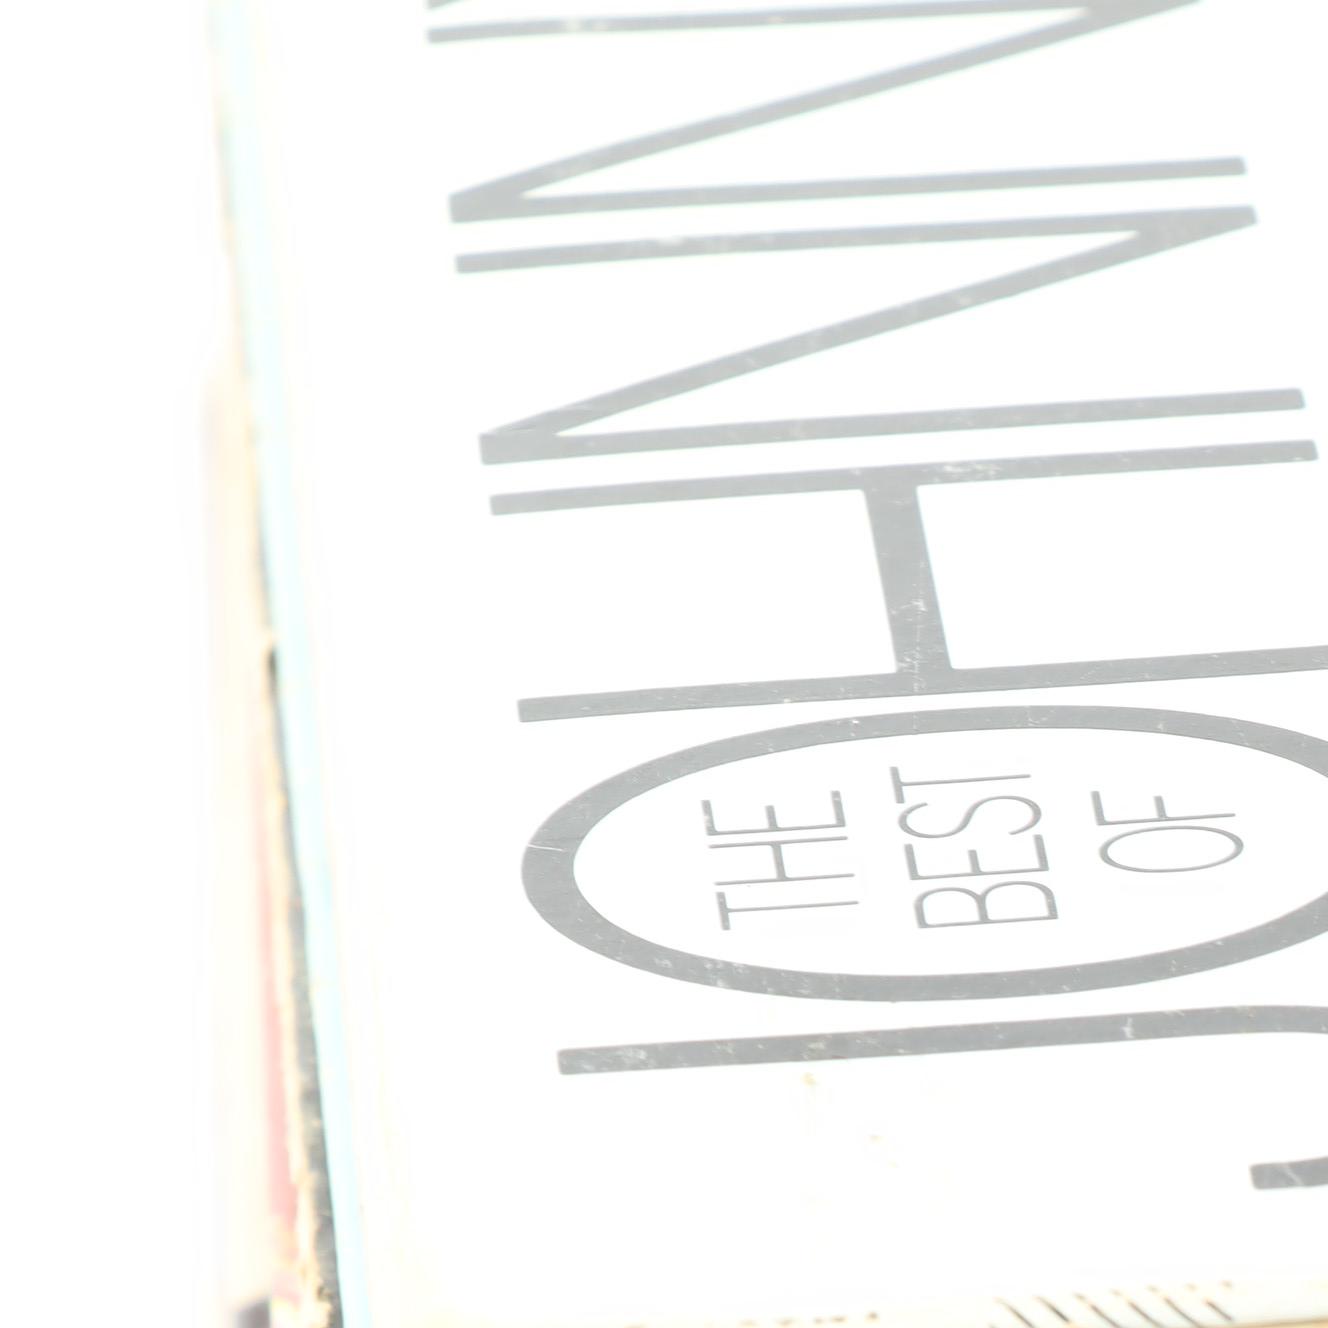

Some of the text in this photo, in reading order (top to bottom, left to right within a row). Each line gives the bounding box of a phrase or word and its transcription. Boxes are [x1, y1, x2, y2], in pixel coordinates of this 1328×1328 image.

[702, 790, 859, 930] THE
[890, 766, 1058, 929] BEST
[1090, 790, 1244, 874] OF
